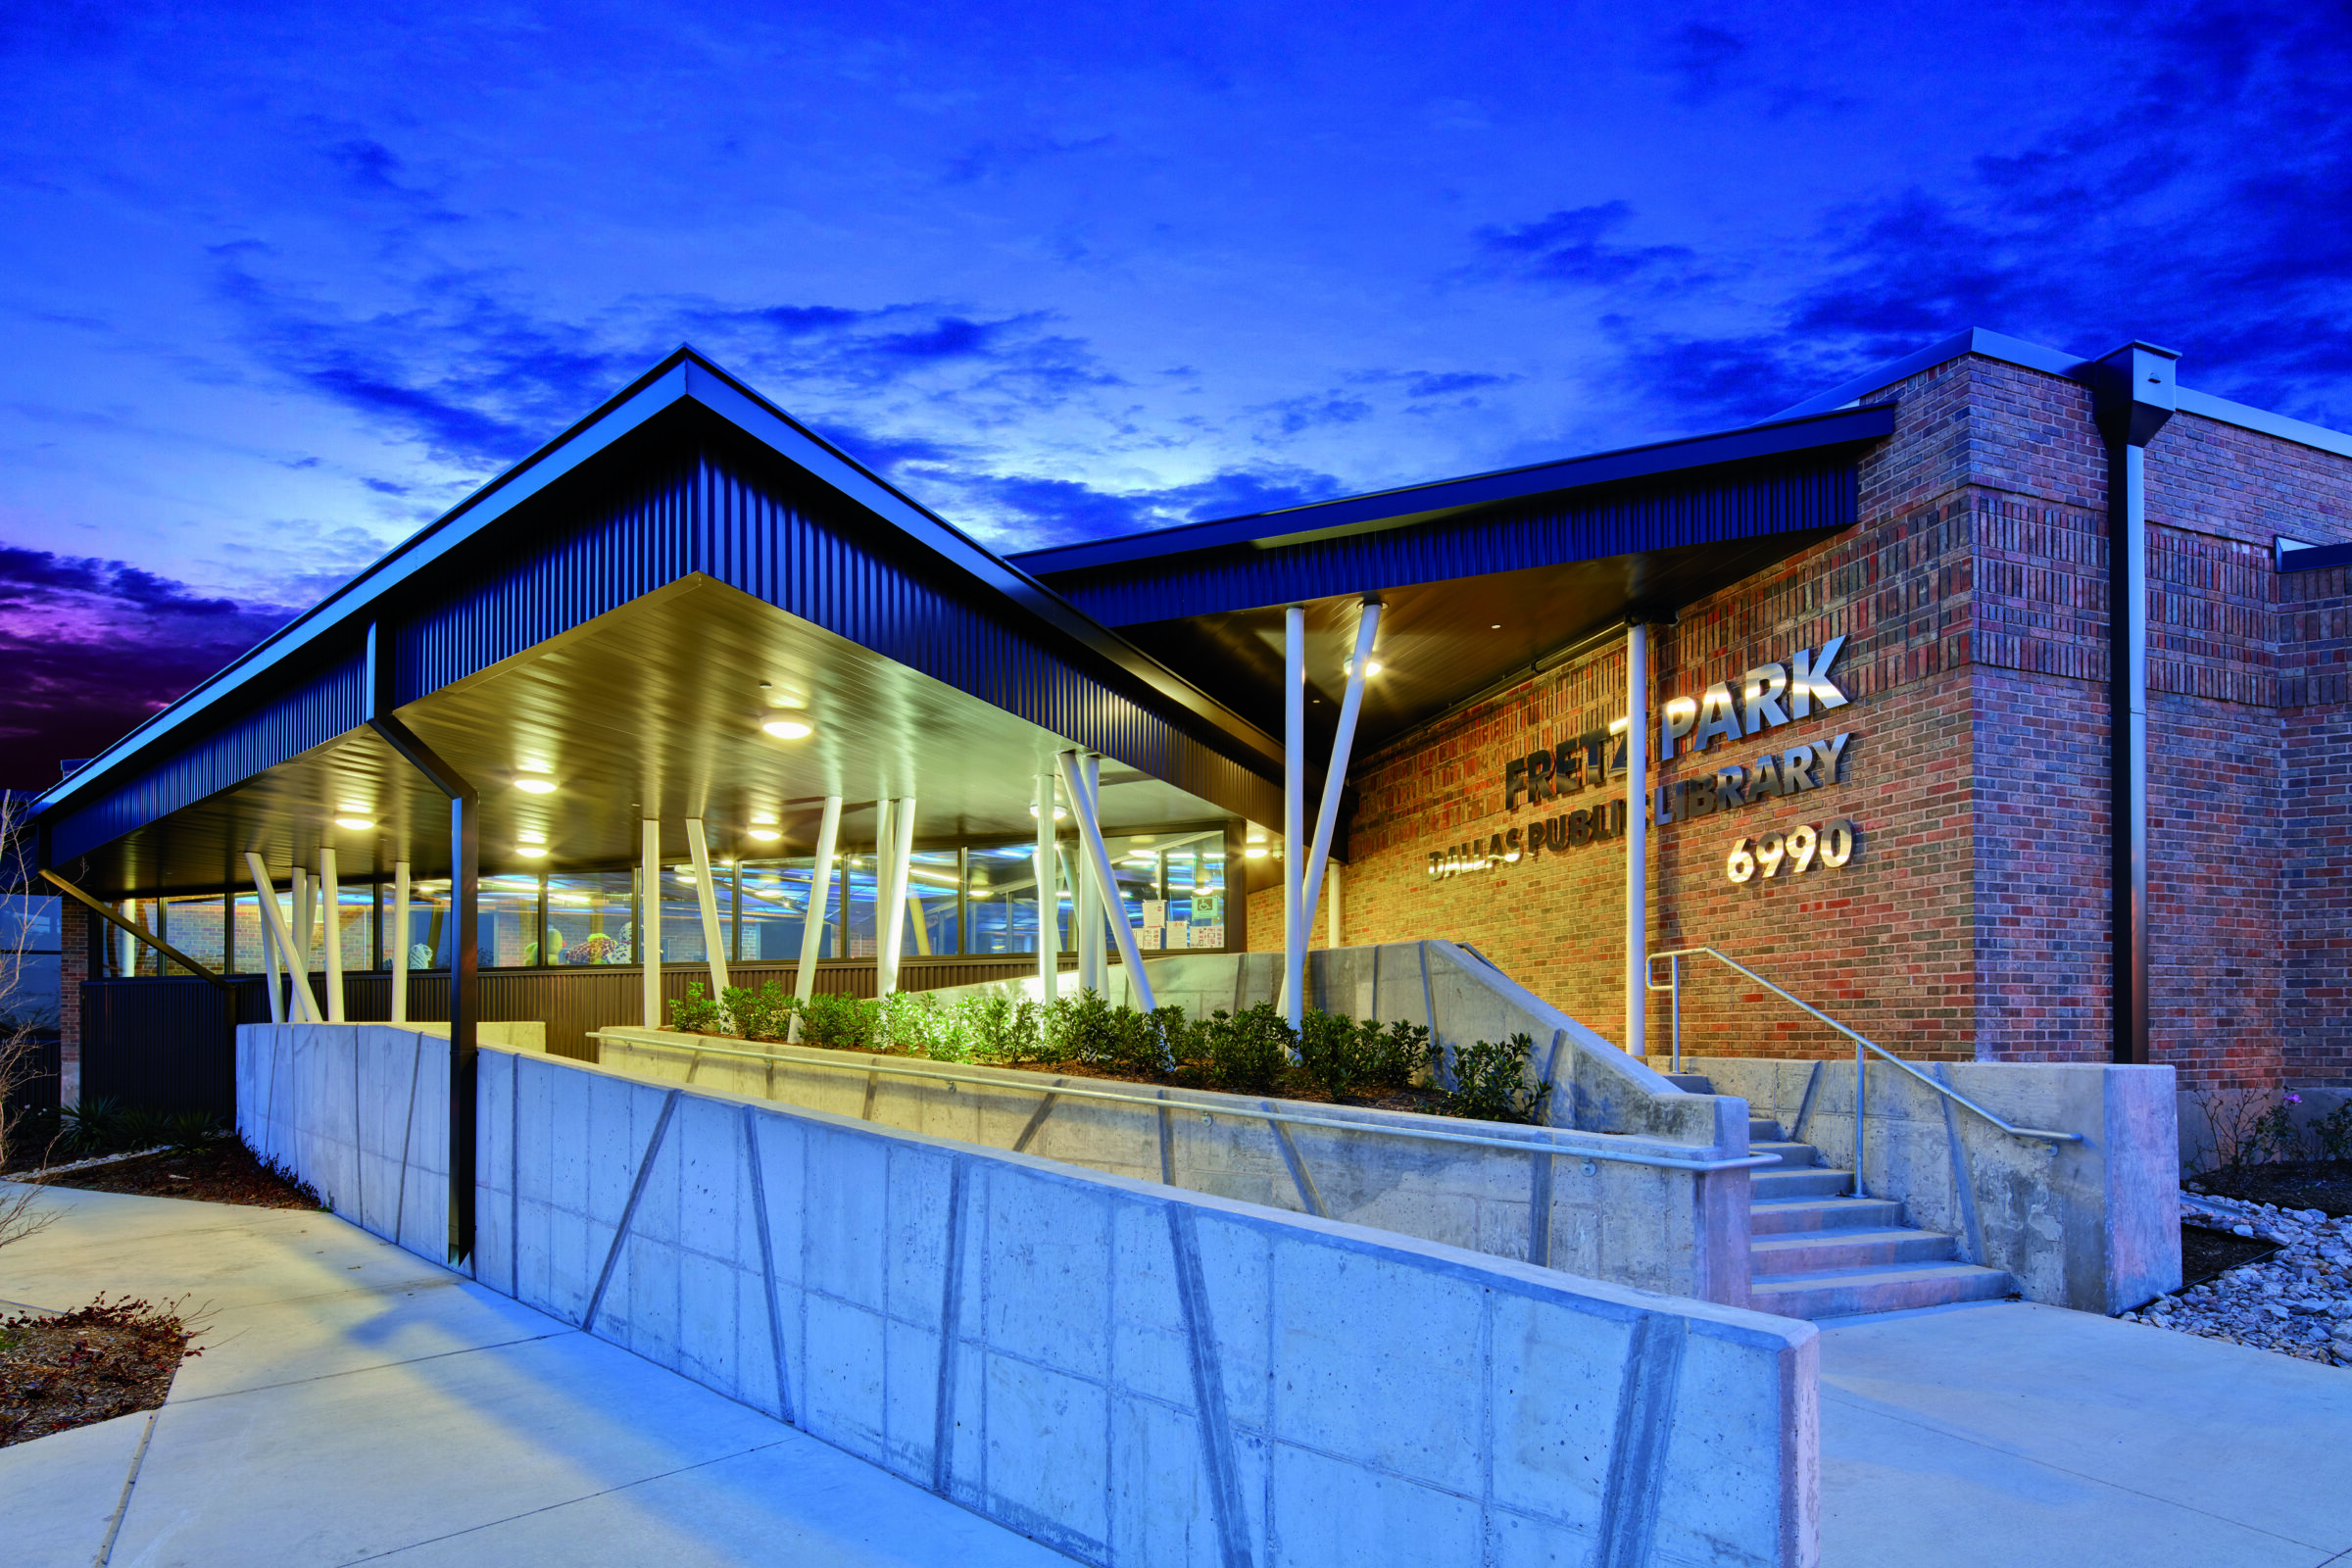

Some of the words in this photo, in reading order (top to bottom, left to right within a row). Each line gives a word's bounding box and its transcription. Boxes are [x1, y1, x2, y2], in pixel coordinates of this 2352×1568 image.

[1661, 634, 1849, 761] PARK
[1428, 827, 1521, 881] DALLAS
[1528, 799, 1626, 857] PUBLI
[1654, 732, 1850, 826] LIBRARY
[1727, 818, 1852, 883] 6990
